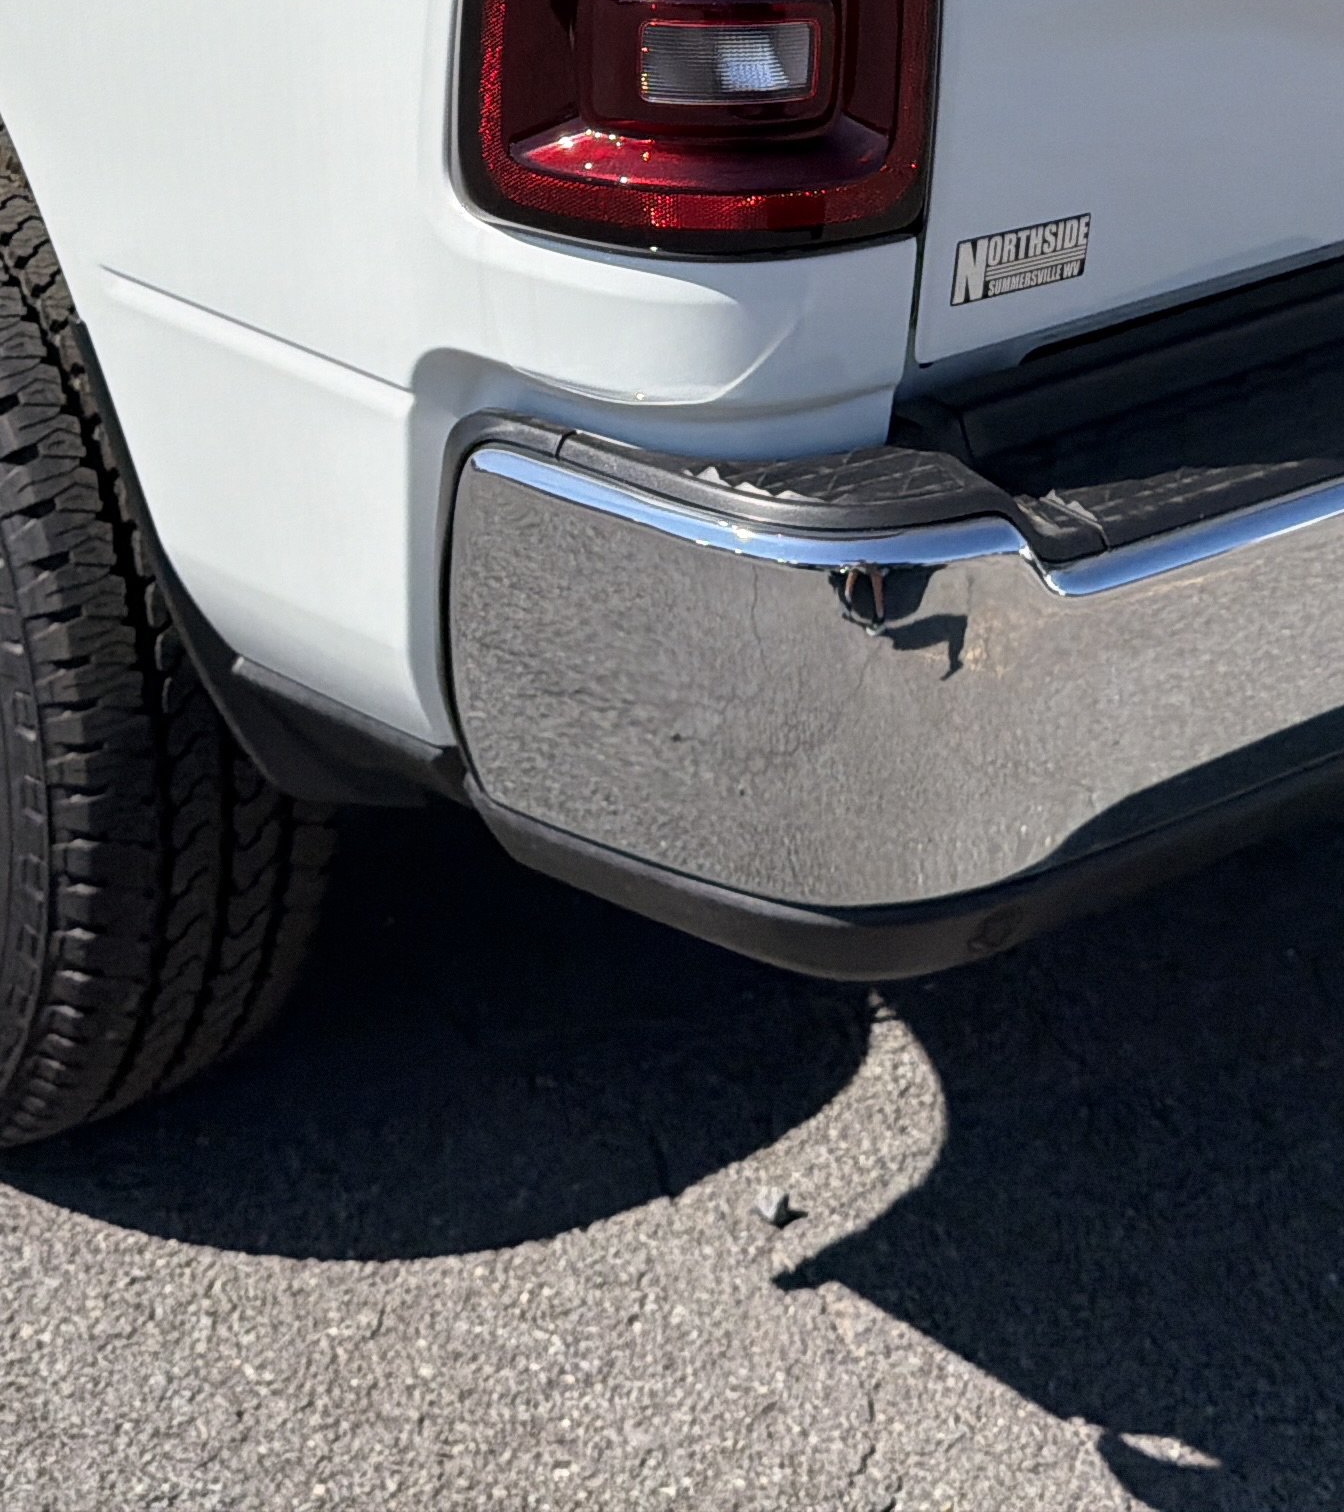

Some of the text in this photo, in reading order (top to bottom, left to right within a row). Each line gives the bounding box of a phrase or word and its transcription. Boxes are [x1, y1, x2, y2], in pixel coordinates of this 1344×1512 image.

[951, 215, 1091, 306] NORTHSIDE
[987, 259, 1082, 297] SUMMERSVILLE WV
